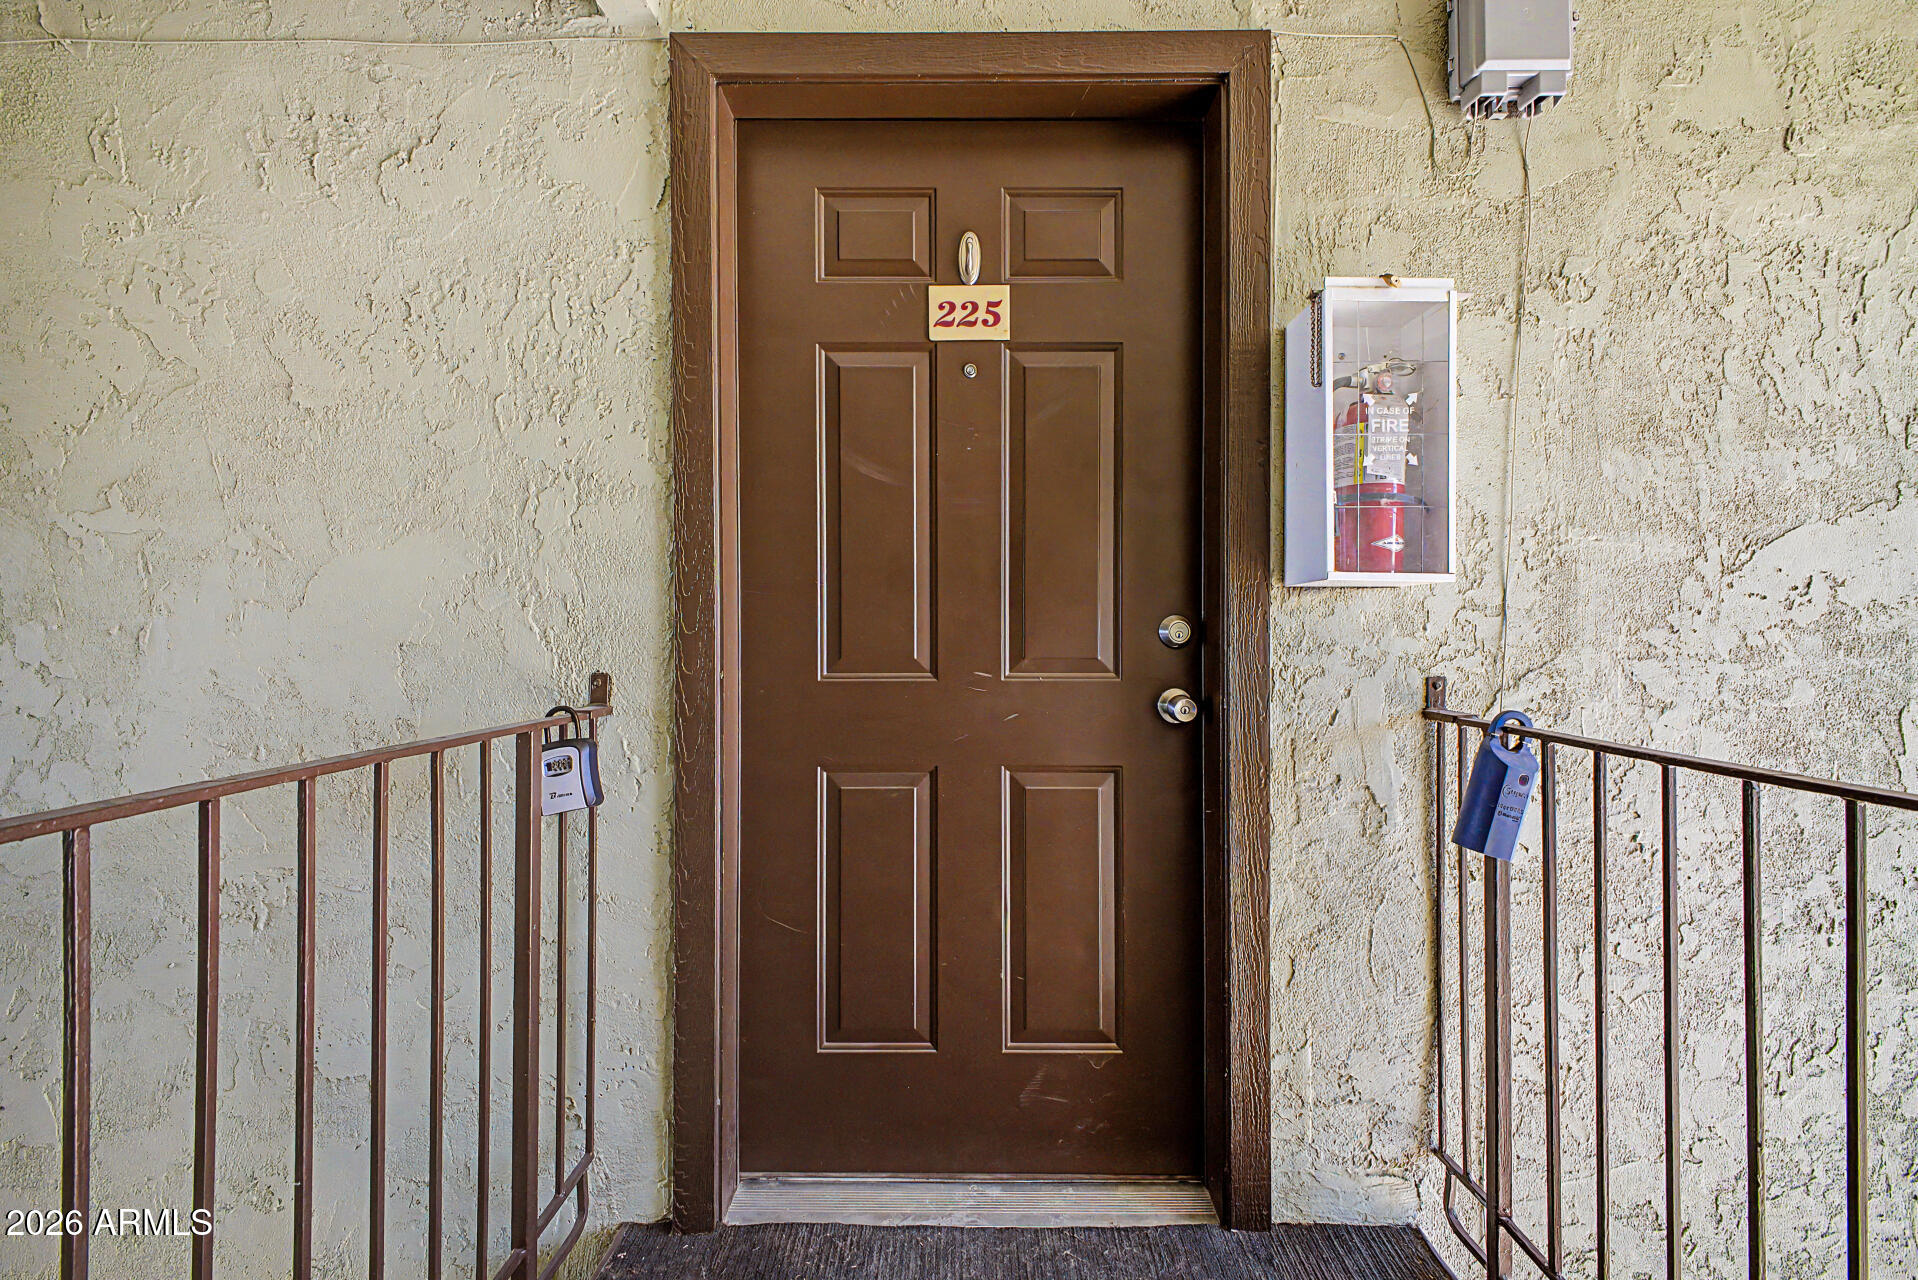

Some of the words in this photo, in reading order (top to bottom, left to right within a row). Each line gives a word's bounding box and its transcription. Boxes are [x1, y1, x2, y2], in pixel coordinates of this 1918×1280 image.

[933, 299, 1003, 328] 225
[1365, 407, 1374, 415] IN
[1376, 407, 1400, 415] CASE
[1402, 407, 1415, 415] OF
[1371, 418, 1410, 433] FIRE
